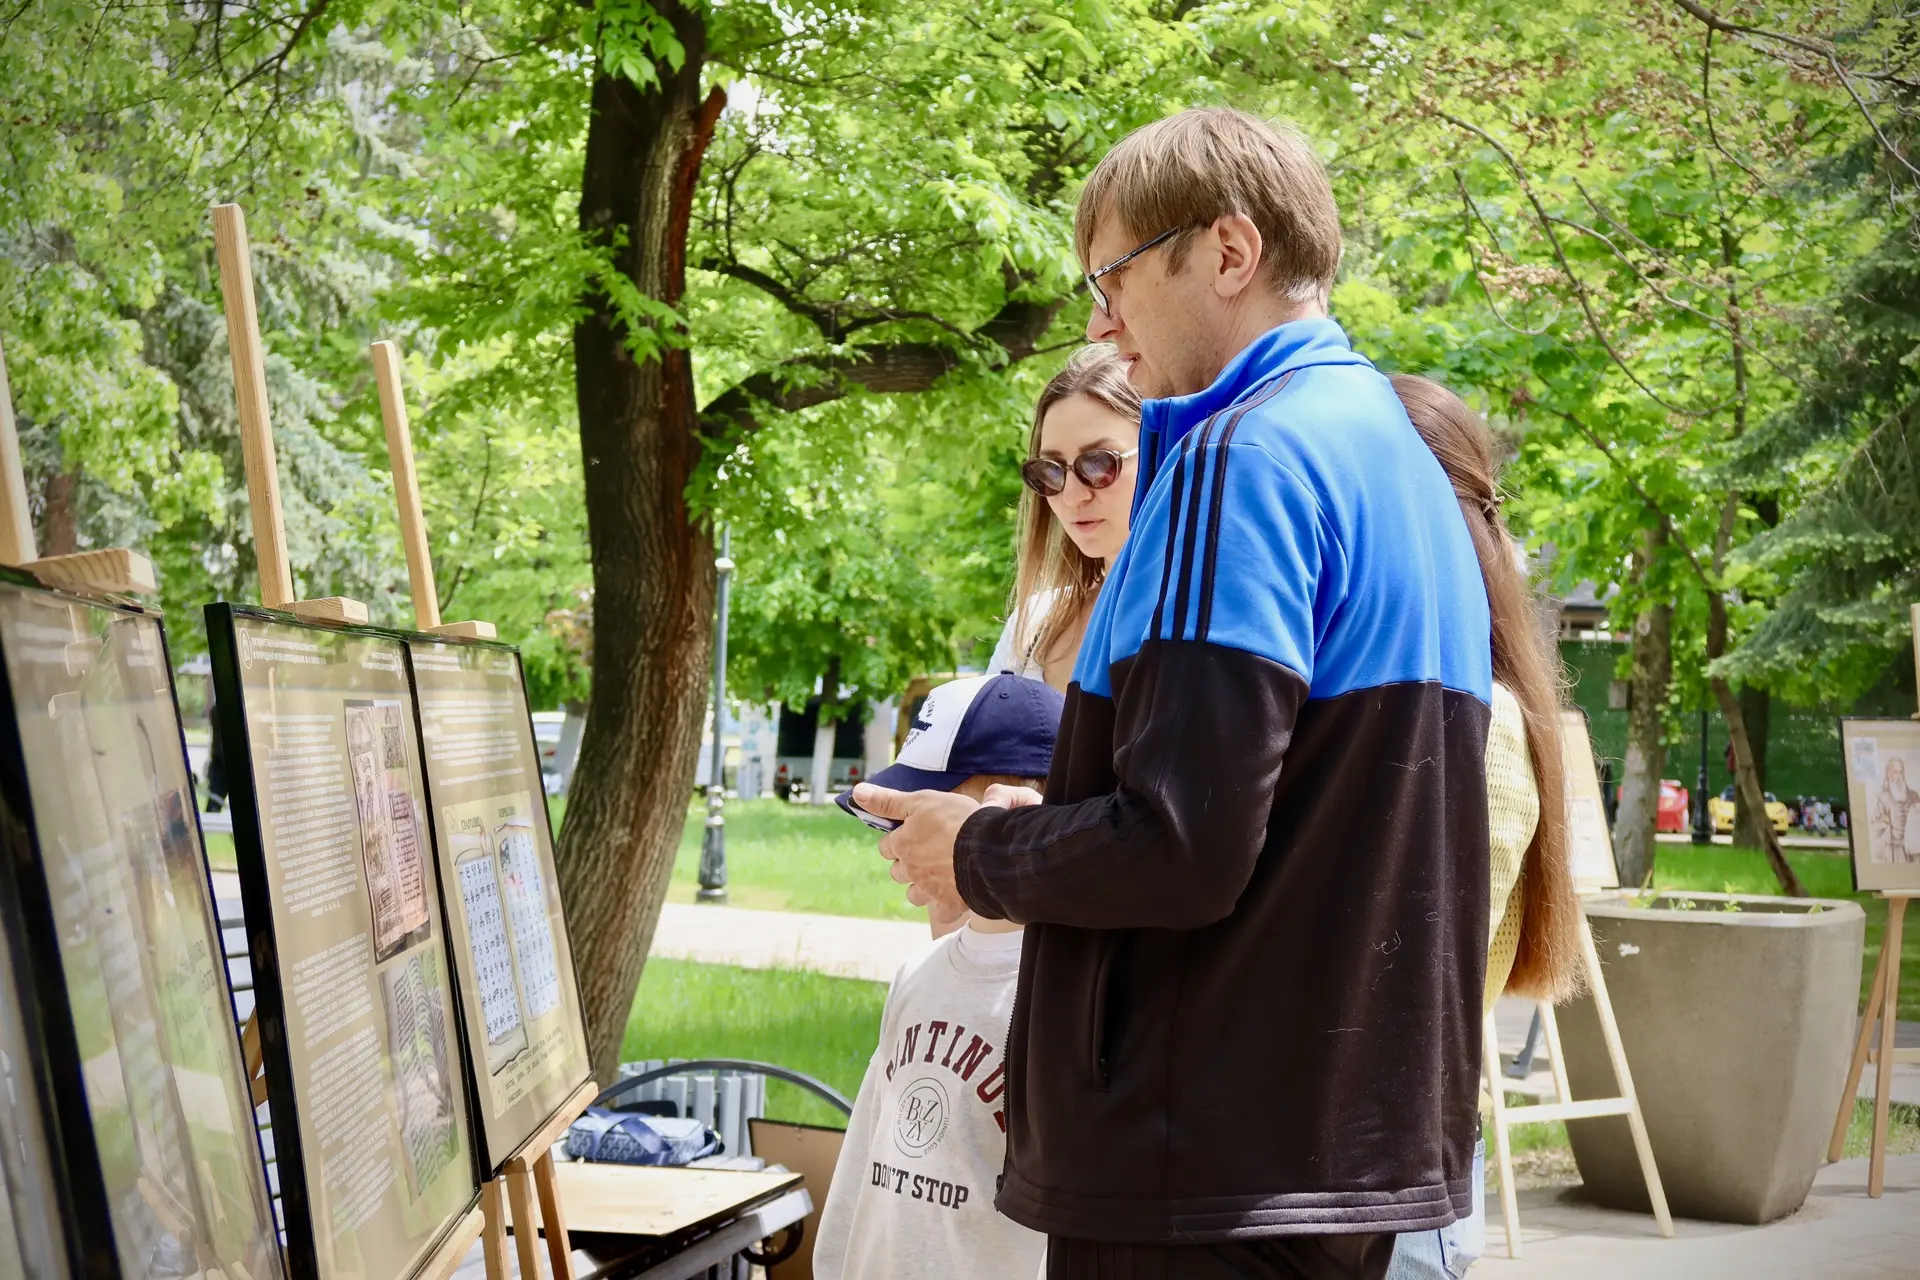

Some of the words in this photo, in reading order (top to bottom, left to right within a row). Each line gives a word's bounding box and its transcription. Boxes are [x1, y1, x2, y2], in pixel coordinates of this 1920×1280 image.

[886, 1020, 1007, 1133] NTINU
[937, 1117, 950, 1143] JUNIOR
[923, 1142, 938, 1155] CLUB
[911, 1174, 969, 1210] STOP
